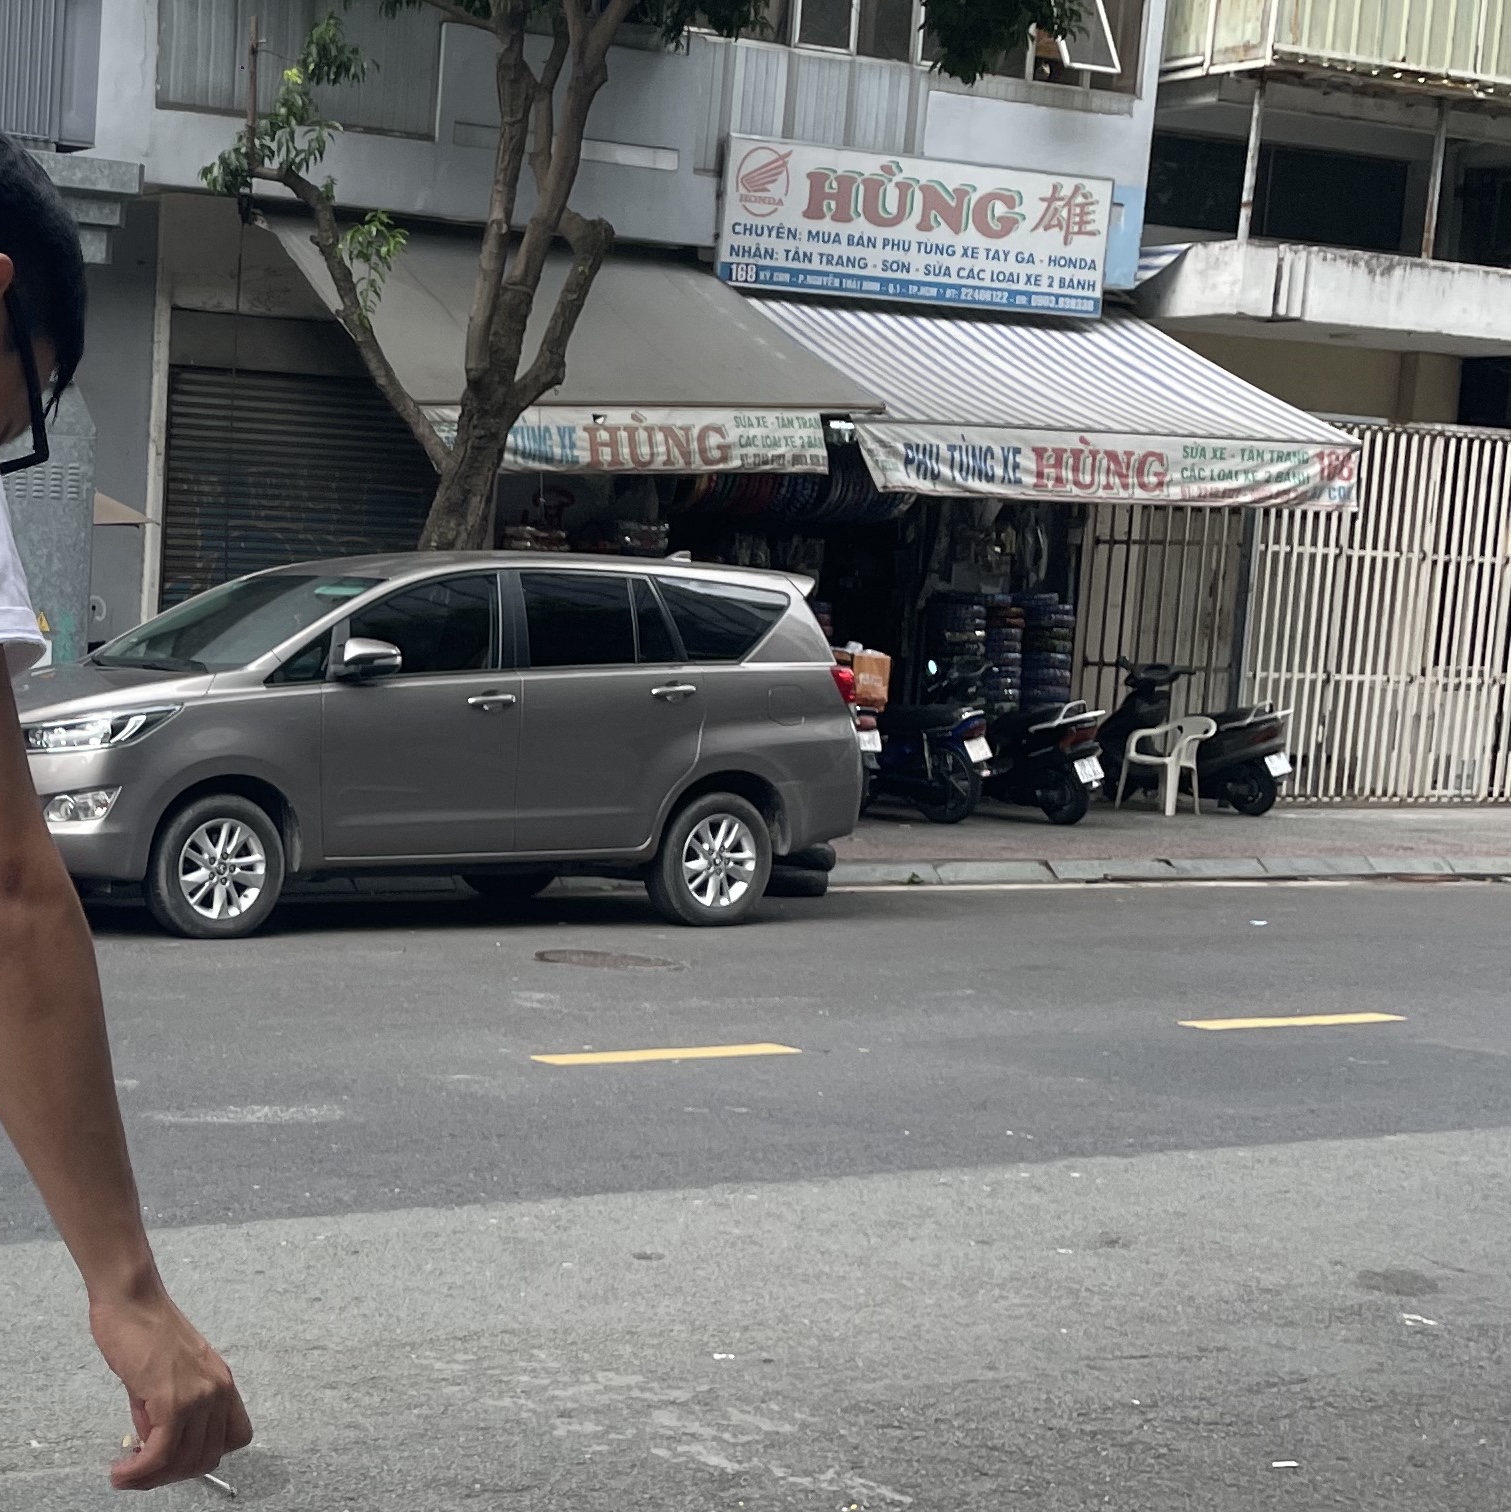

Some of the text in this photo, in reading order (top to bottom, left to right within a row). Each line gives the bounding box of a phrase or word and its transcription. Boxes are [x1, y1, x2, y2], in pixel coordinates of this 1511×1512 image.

[739, 193, 784, 206] HONDA
[802, 159, 1027, 240] HÙNG
[1030, 181, 1102, 246] 雄
[729, 242, 779, 262] NHẬN:
[783, 246, 813, 264] TÂN
[817, 252, 868, 270] TRANG
[881, 258, 911, 274] SƠN
[956, 264, 987, 282] CÁC
[990, 269, 1020, 287] LOẠI
[1024, 273, 1042, 287] XE
[1047, 275, 1055, 288] 2
[1059, 274, 1096, 292] BÁNH
[732, 222, 1097, 271] CHUYÊN: MUA BÁN PHỤ TÙNG XE TAY GA HONDA
[556, 425, 580, 465] XE
[583, 410, 733, 471] HÙNG
[756, 415, 769, 429] XE
[782, 435, 797, 449] XE
[798, 435, 805, 449] 2
[904, 433, 1023, 488] PHỤ TÙNG XE
[1031, 435, 1172, 497] HÙNG
[1180, 463, 1206, 481] CÁC
[1210, 446, 1227, 460] XE
[1239, 445, 1265, 462] TÂN
[1268, 449, 1310, 465] TRANG
